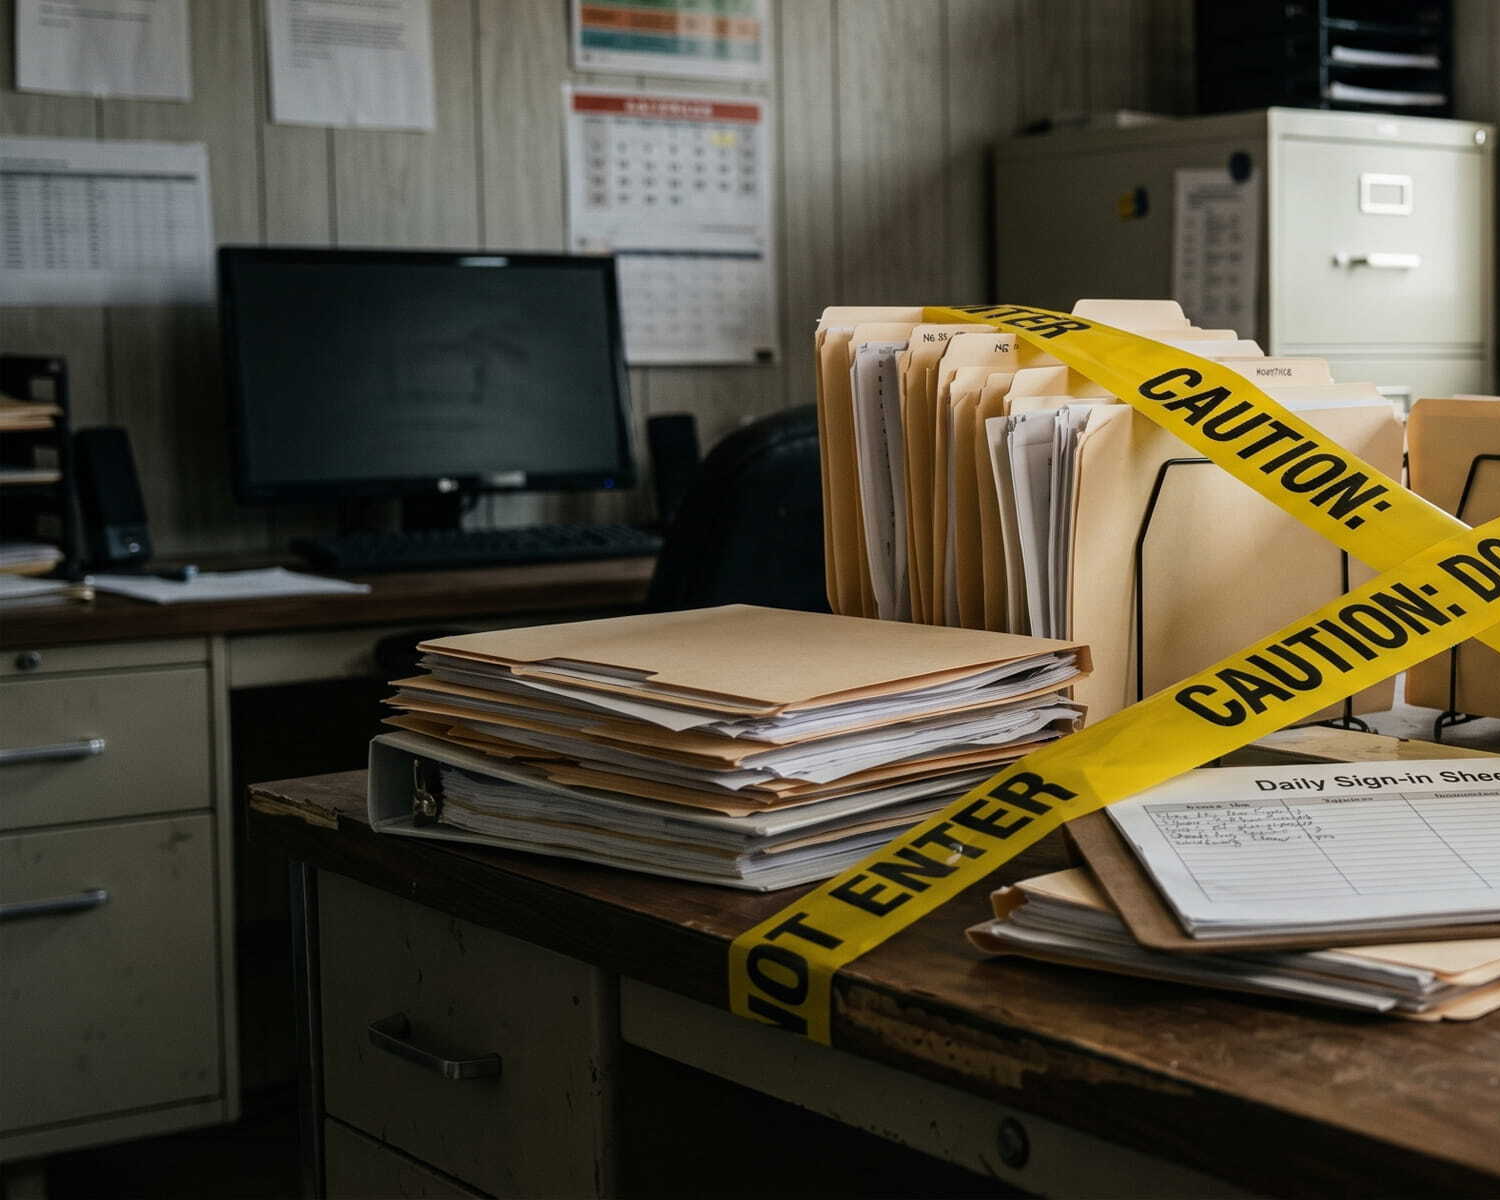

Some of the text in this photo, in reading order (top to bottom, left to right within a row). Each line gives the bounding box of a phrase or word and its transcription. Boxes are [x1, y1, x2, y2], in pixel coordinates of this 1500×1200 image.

[1138, 367, 1392, 530] CAUTION:
[828, 772, 1078, 917] ENTER
[1175, 583, 1467, 727] CAUTION:
[1255, 776, 1325, 791] Daily
[1334, 771, 1433, 789] Sign-in
